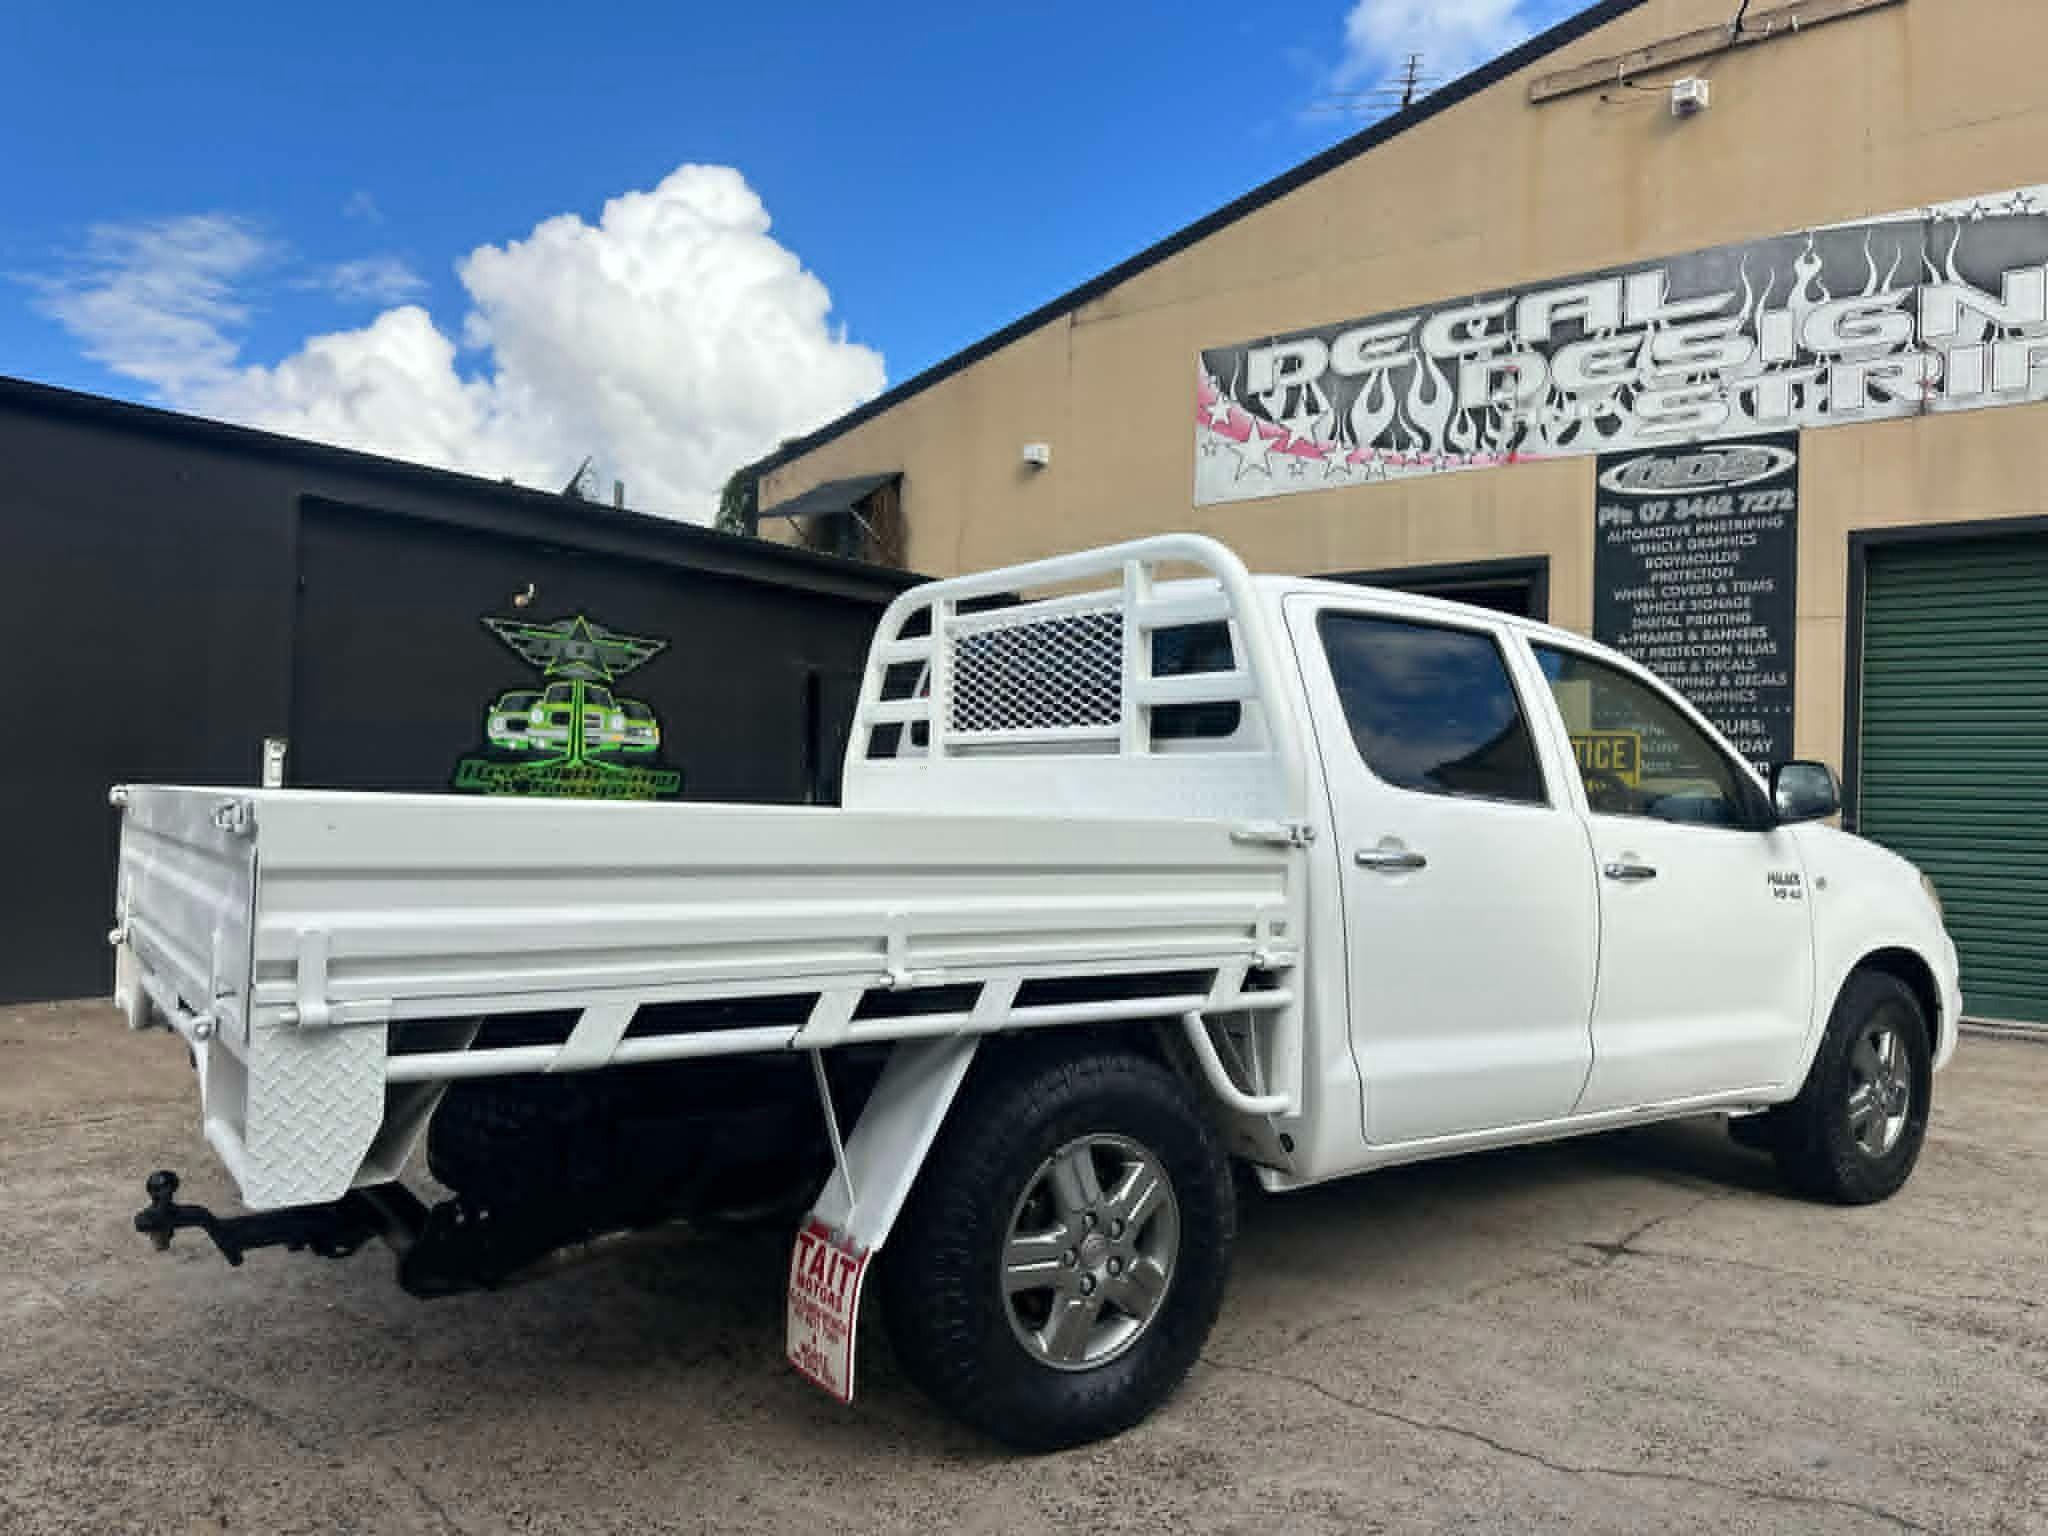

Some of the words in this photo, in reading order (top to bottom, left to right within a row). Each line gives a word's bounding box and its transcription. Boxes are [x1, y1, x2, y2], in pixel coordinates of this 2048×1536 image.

[1639, 500, 1670, 524] 07
[1608, 524, 1690, 545] AUTOMOTIVE
[1632, 540, 1681, 555] VEHICLE
[1687, 533, 1758, 551] GRAPHICS
[1651, 568, 1736, 585] PROTECTION
[1614, 586, 1657, 601] WHEEL
[1661, 582, 1713, 598] COVERS
[1718, 581, 1728, 593] &
[1633, 600, 1682, 616] VEHICLE
[1685, 596, 1750, 612] SIGNAGE
[1632, 614, 1681, 630] DIGITAL
[1686, 611, 1751, 626] PRINTING
[1688, 630, 1698, 642] &
[1703, 625, 1769, 641] BANNERS
[1650, 643, 1733, 658] PROTECTION
[1737, 640, 1778, 656] FILMS
[1704, 657, 1759, 672] DECALS
[1734, 671, 1788, 687] DECALS
[798, 1232, 857, 1294] TAIT
